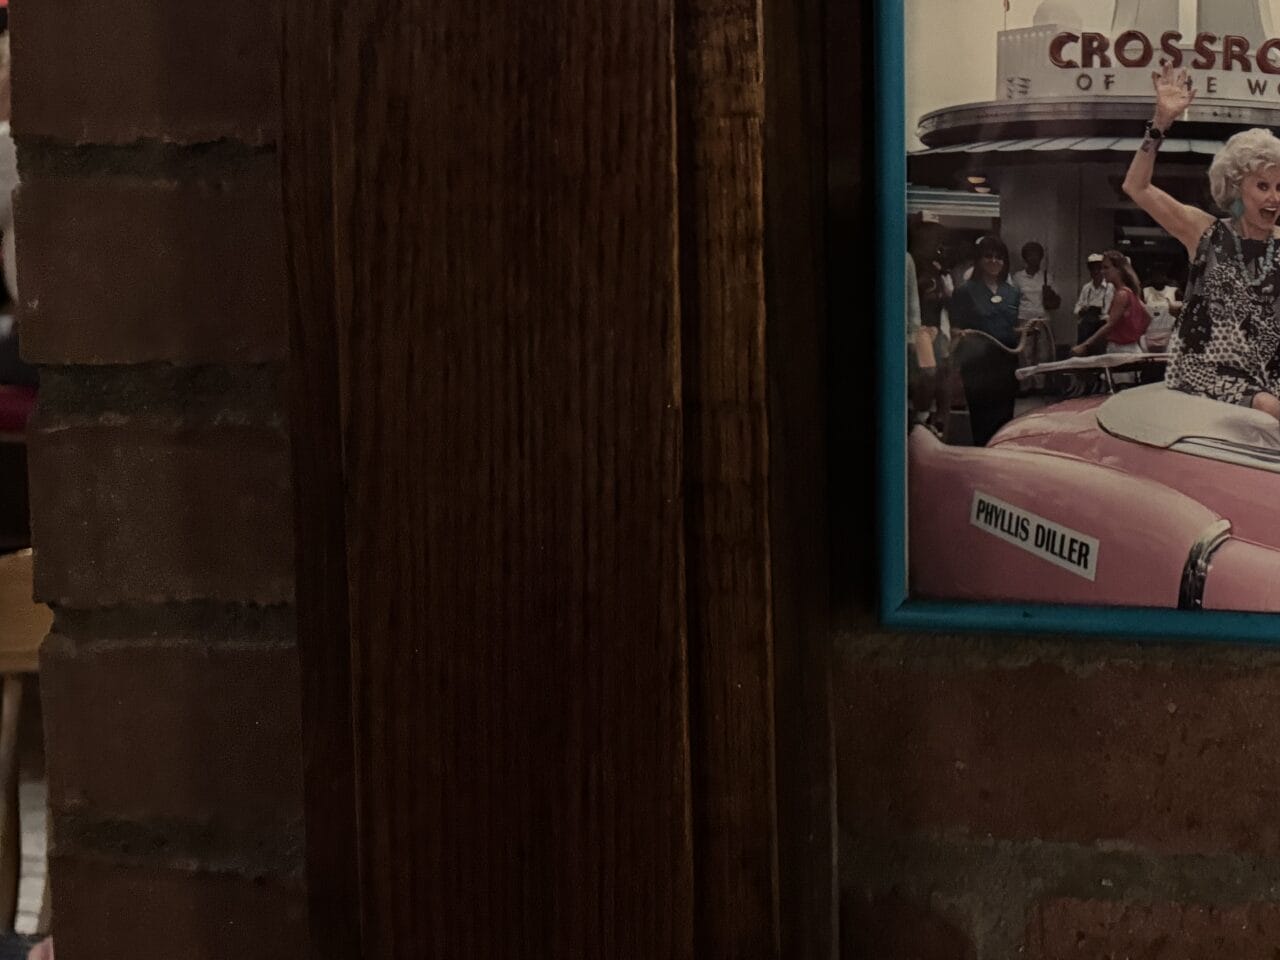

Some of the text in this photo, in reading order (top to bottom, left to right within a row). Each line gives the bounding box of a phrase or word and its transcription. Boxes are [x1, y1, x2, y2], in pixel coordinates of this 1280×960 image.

[1076, 73, 1115, 91] OF
[976, 499, 1090, 569] PHYLLIS DILLER
